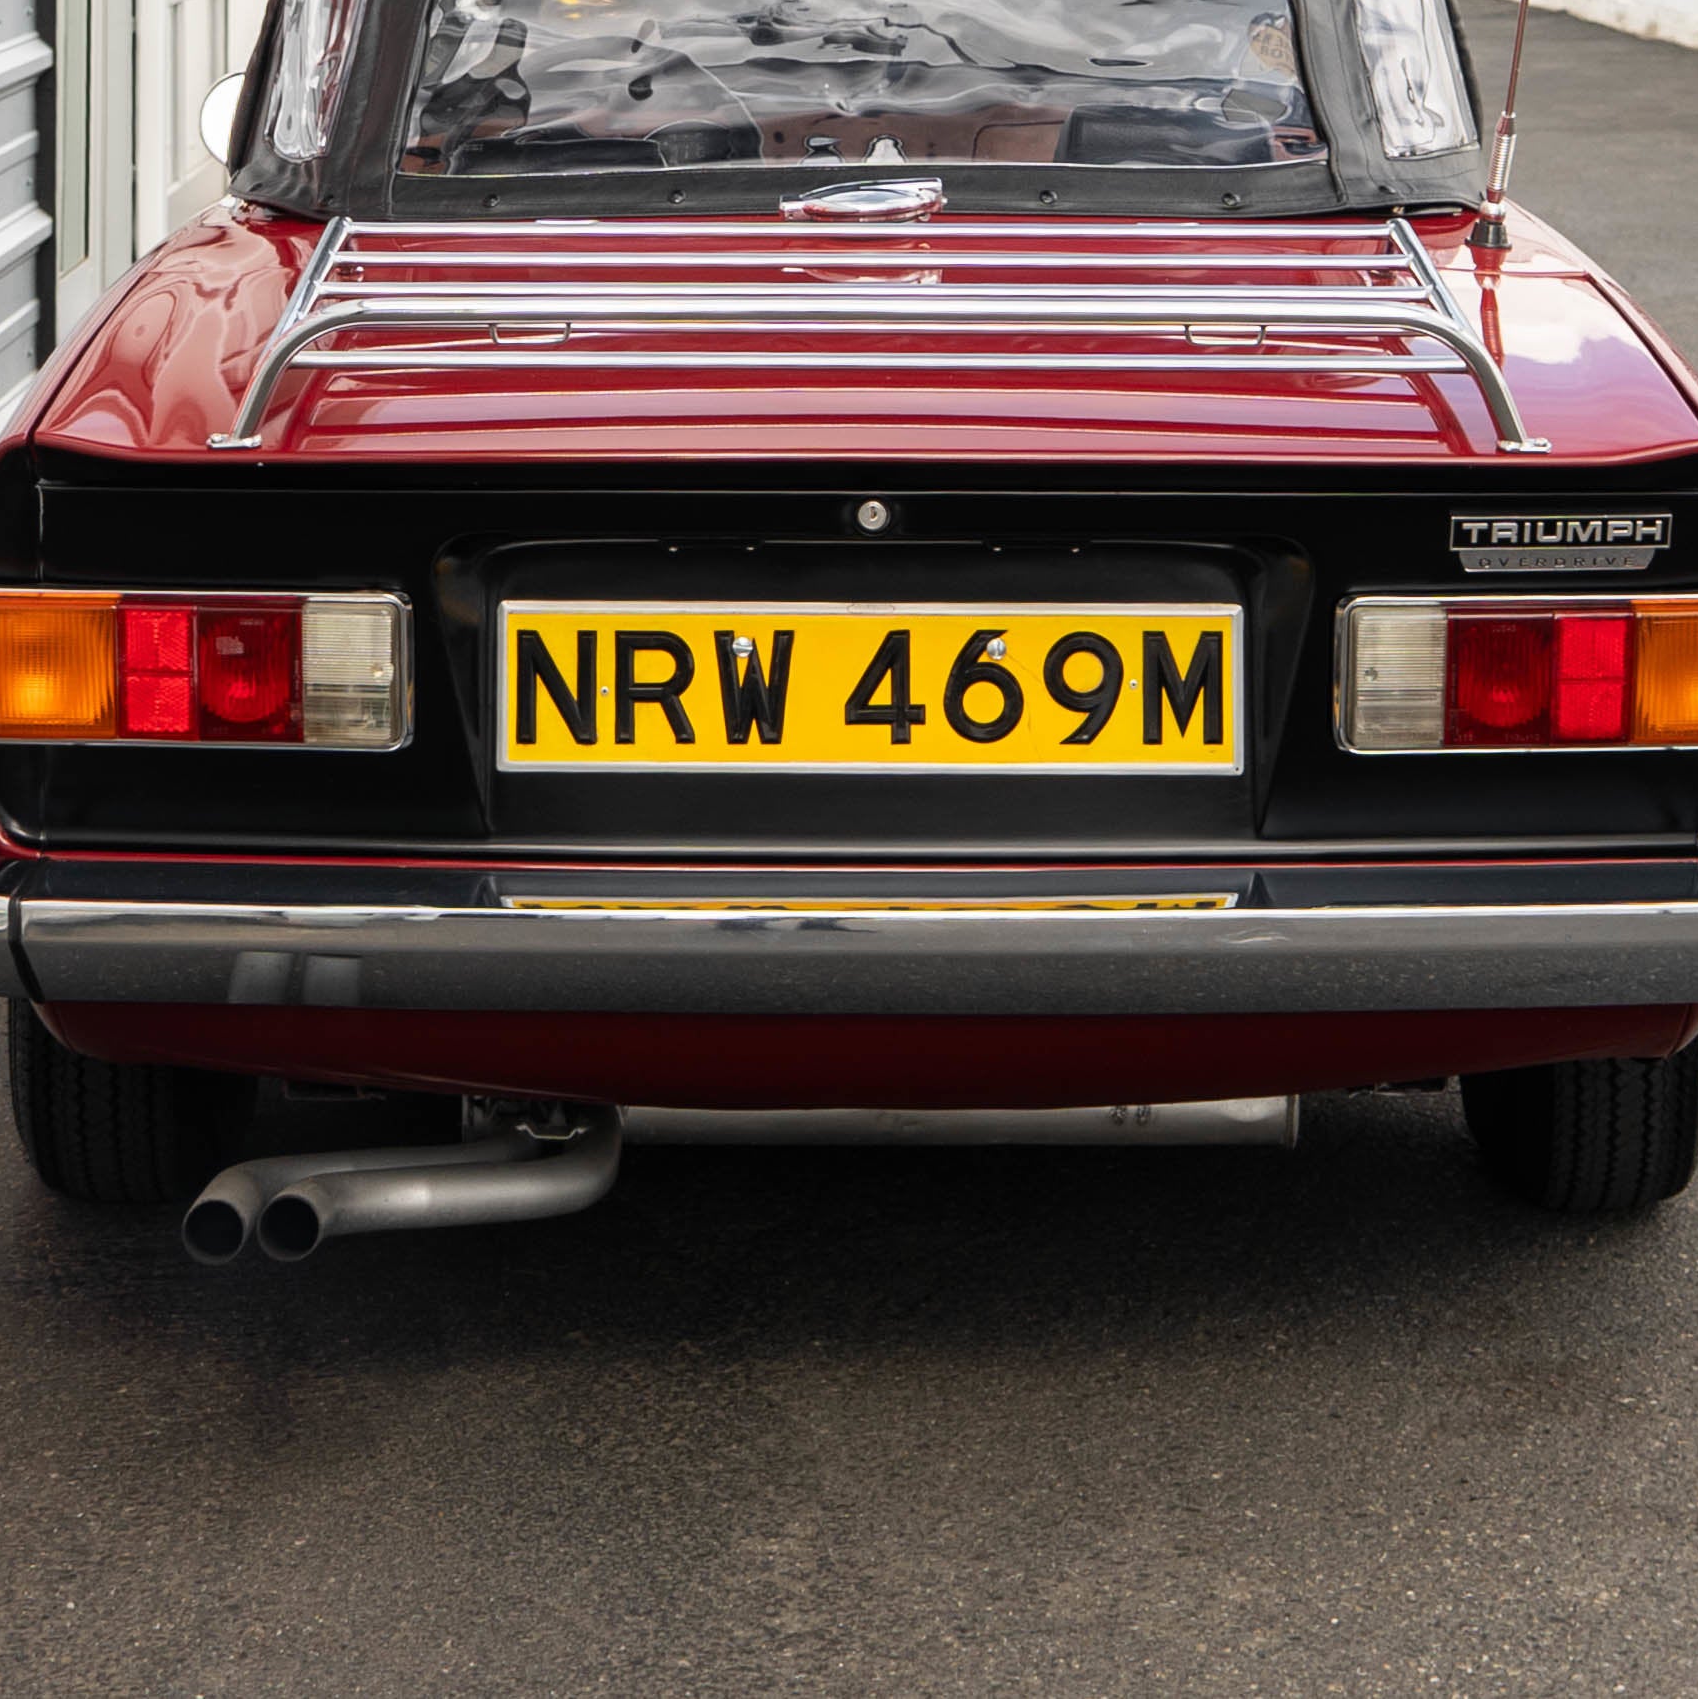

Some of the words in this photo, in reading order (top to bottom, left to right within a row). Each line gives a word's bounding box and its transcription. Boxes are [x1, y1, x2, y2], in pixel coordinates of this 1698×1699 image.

[1461, 520, 1663, 544] TRIUMPH
[1478, 557, 1635, 568] OVERDRIVE
[514, 628, 795, 746] NRW
[844, 628, 1225, 746] 469M
